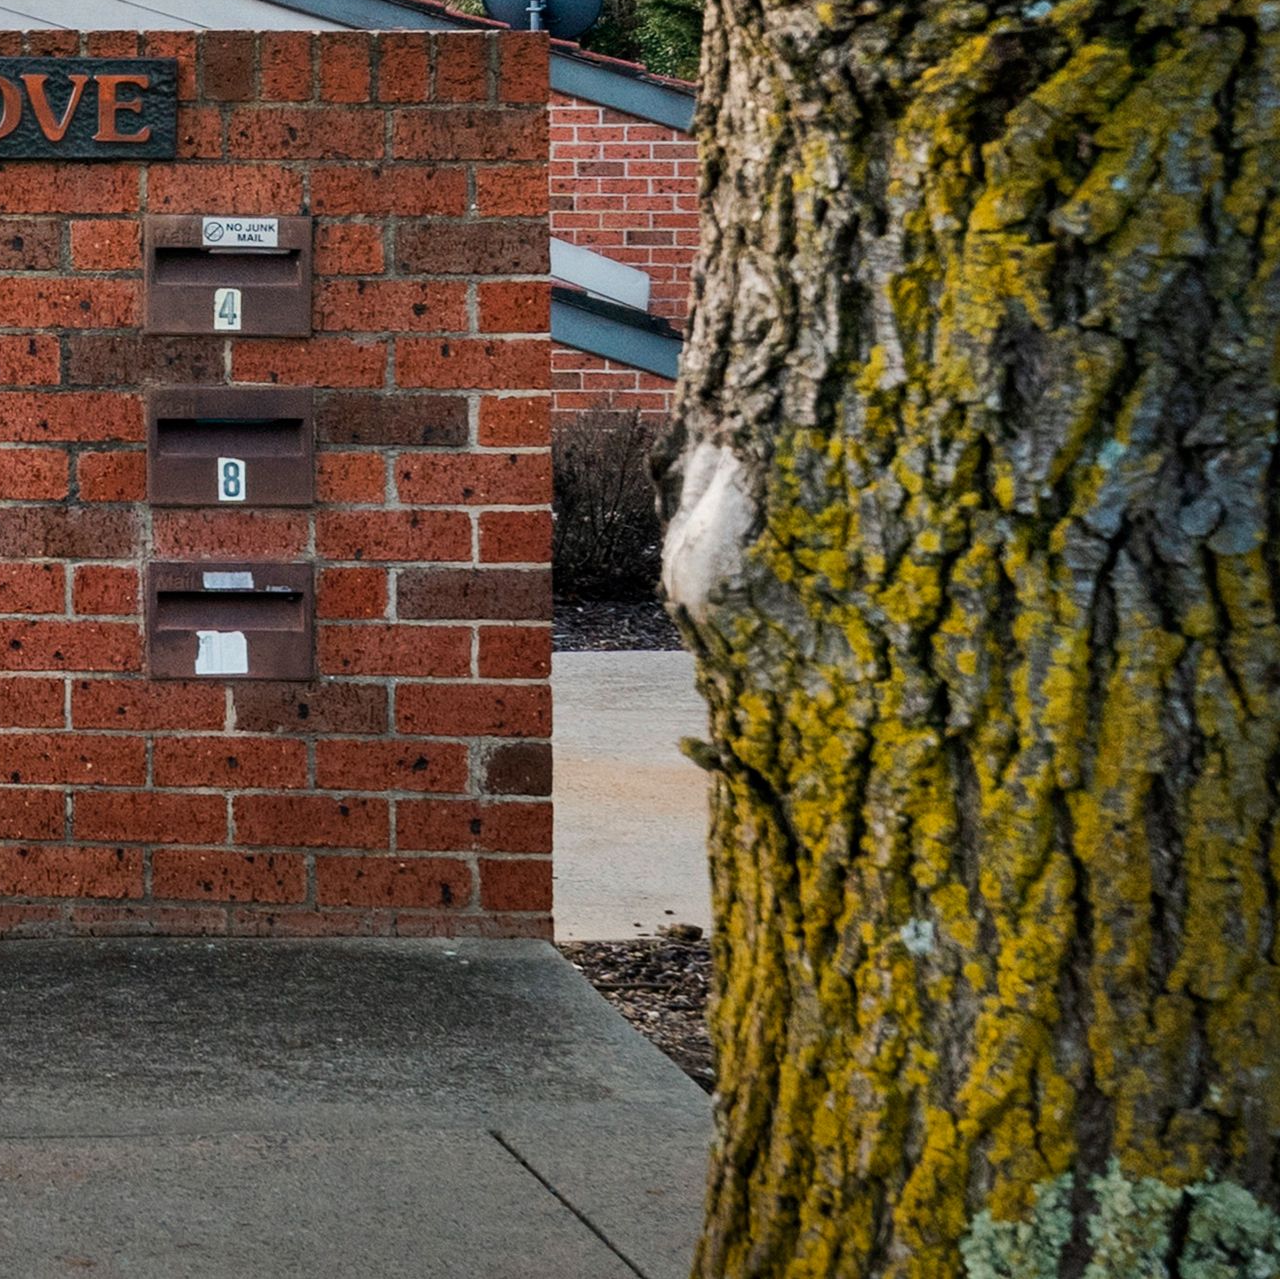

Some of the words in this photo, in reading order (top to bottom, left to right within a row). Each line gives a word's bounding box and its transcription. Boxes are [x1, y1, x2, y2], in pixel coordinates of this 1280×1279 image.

[226, 223, 242, 232] NO
[245, 223, 276, 233] JUNK
[237, 233, 264, 242] MAIL
[219, 292, 237, 325] 4
[223, 462, 240, 497] 8
